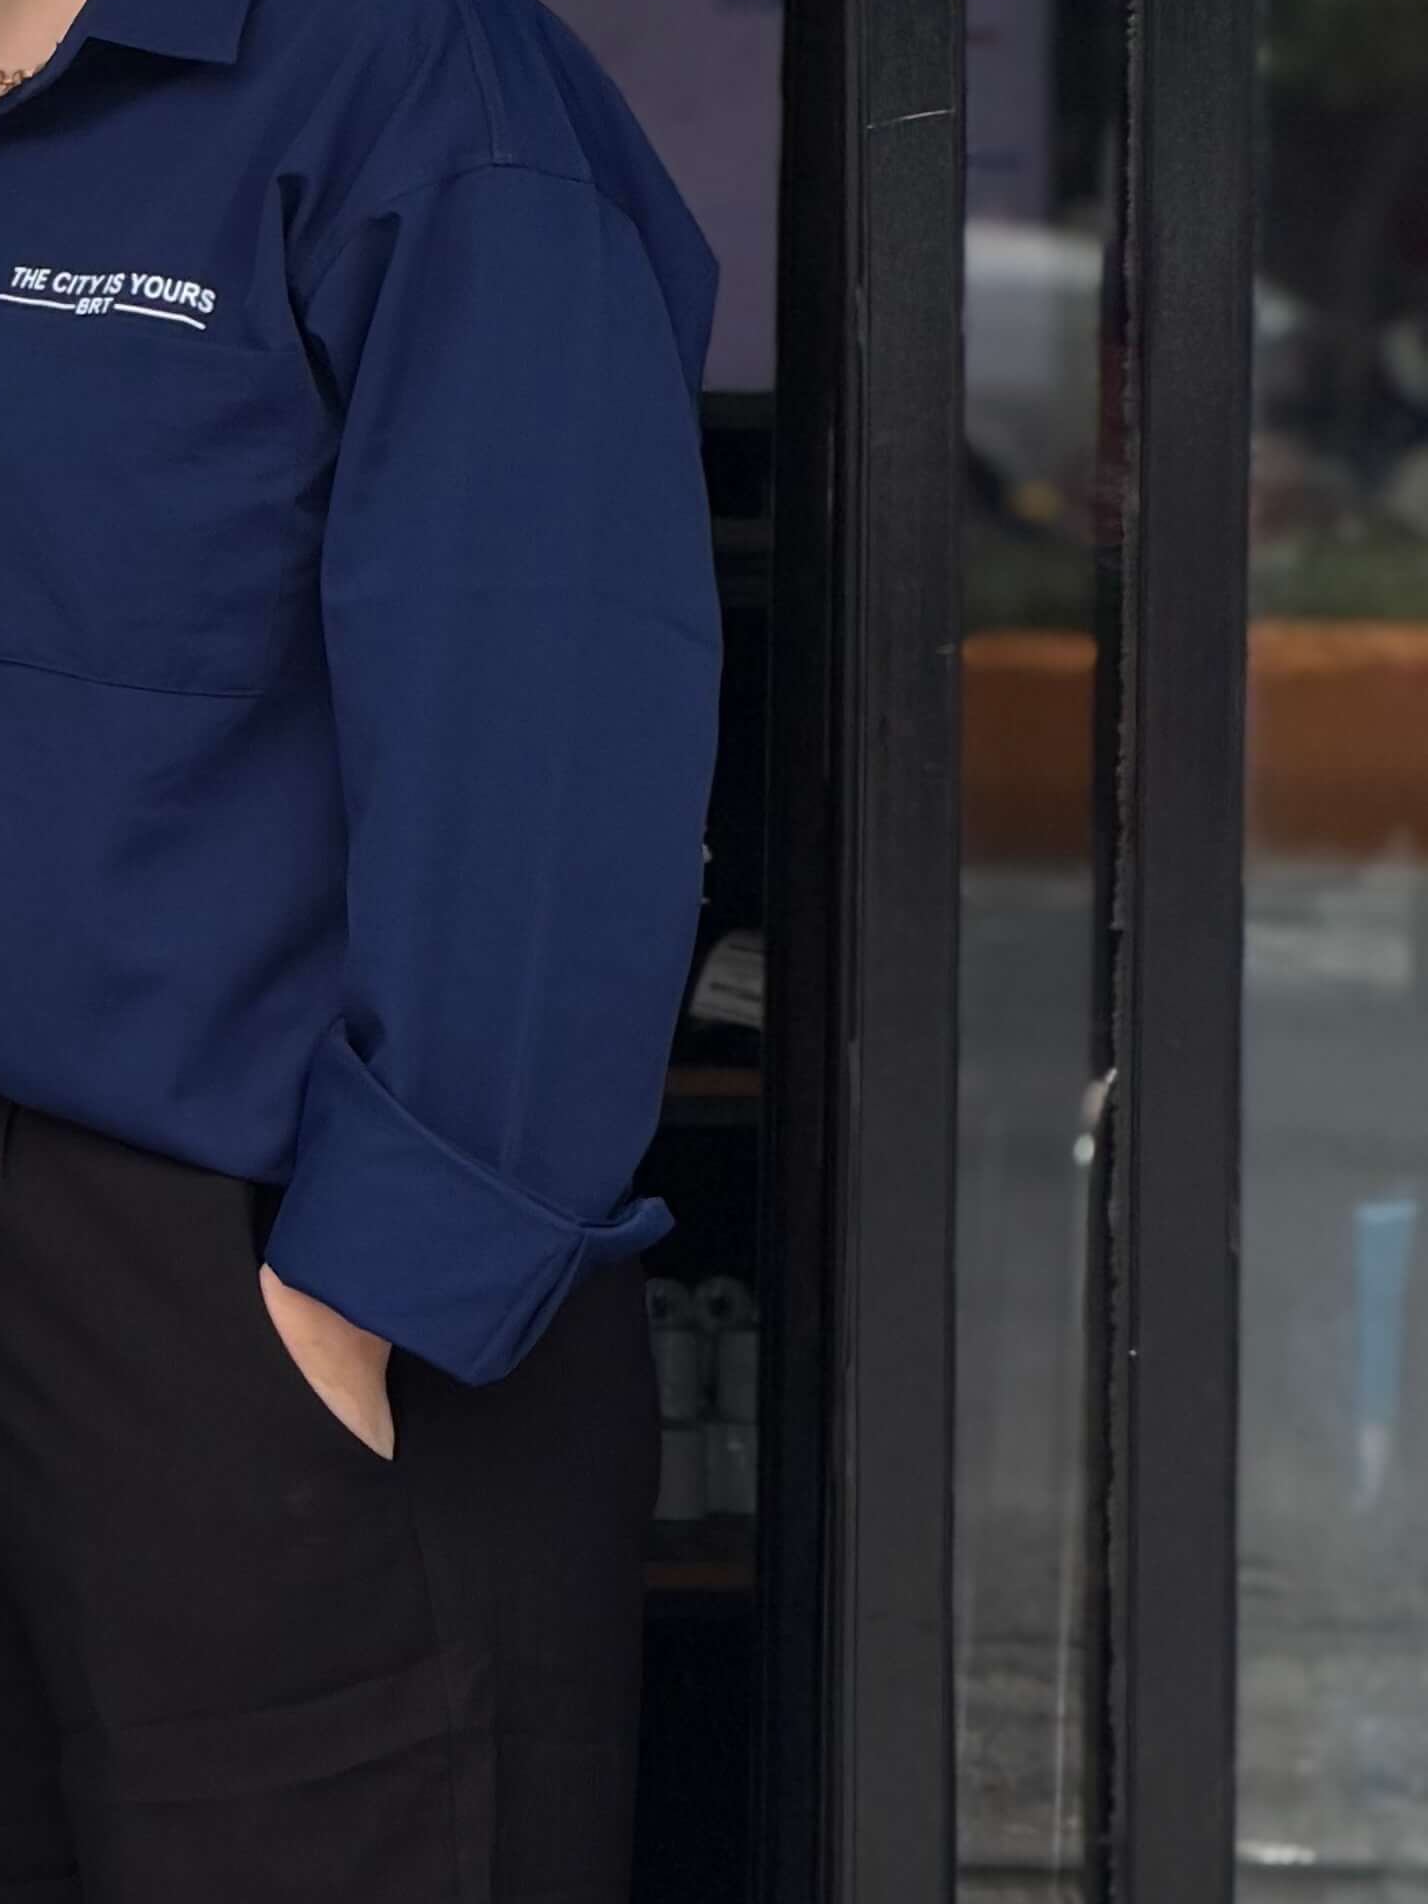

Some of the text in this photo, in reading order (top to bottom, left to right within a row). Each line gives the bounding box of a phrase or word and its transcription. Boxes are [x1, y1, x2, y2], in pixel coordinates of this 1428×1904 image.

[11, 266, 217, 314] THE CITY IS YOURS
[75, 297, 114, 315] BRT
